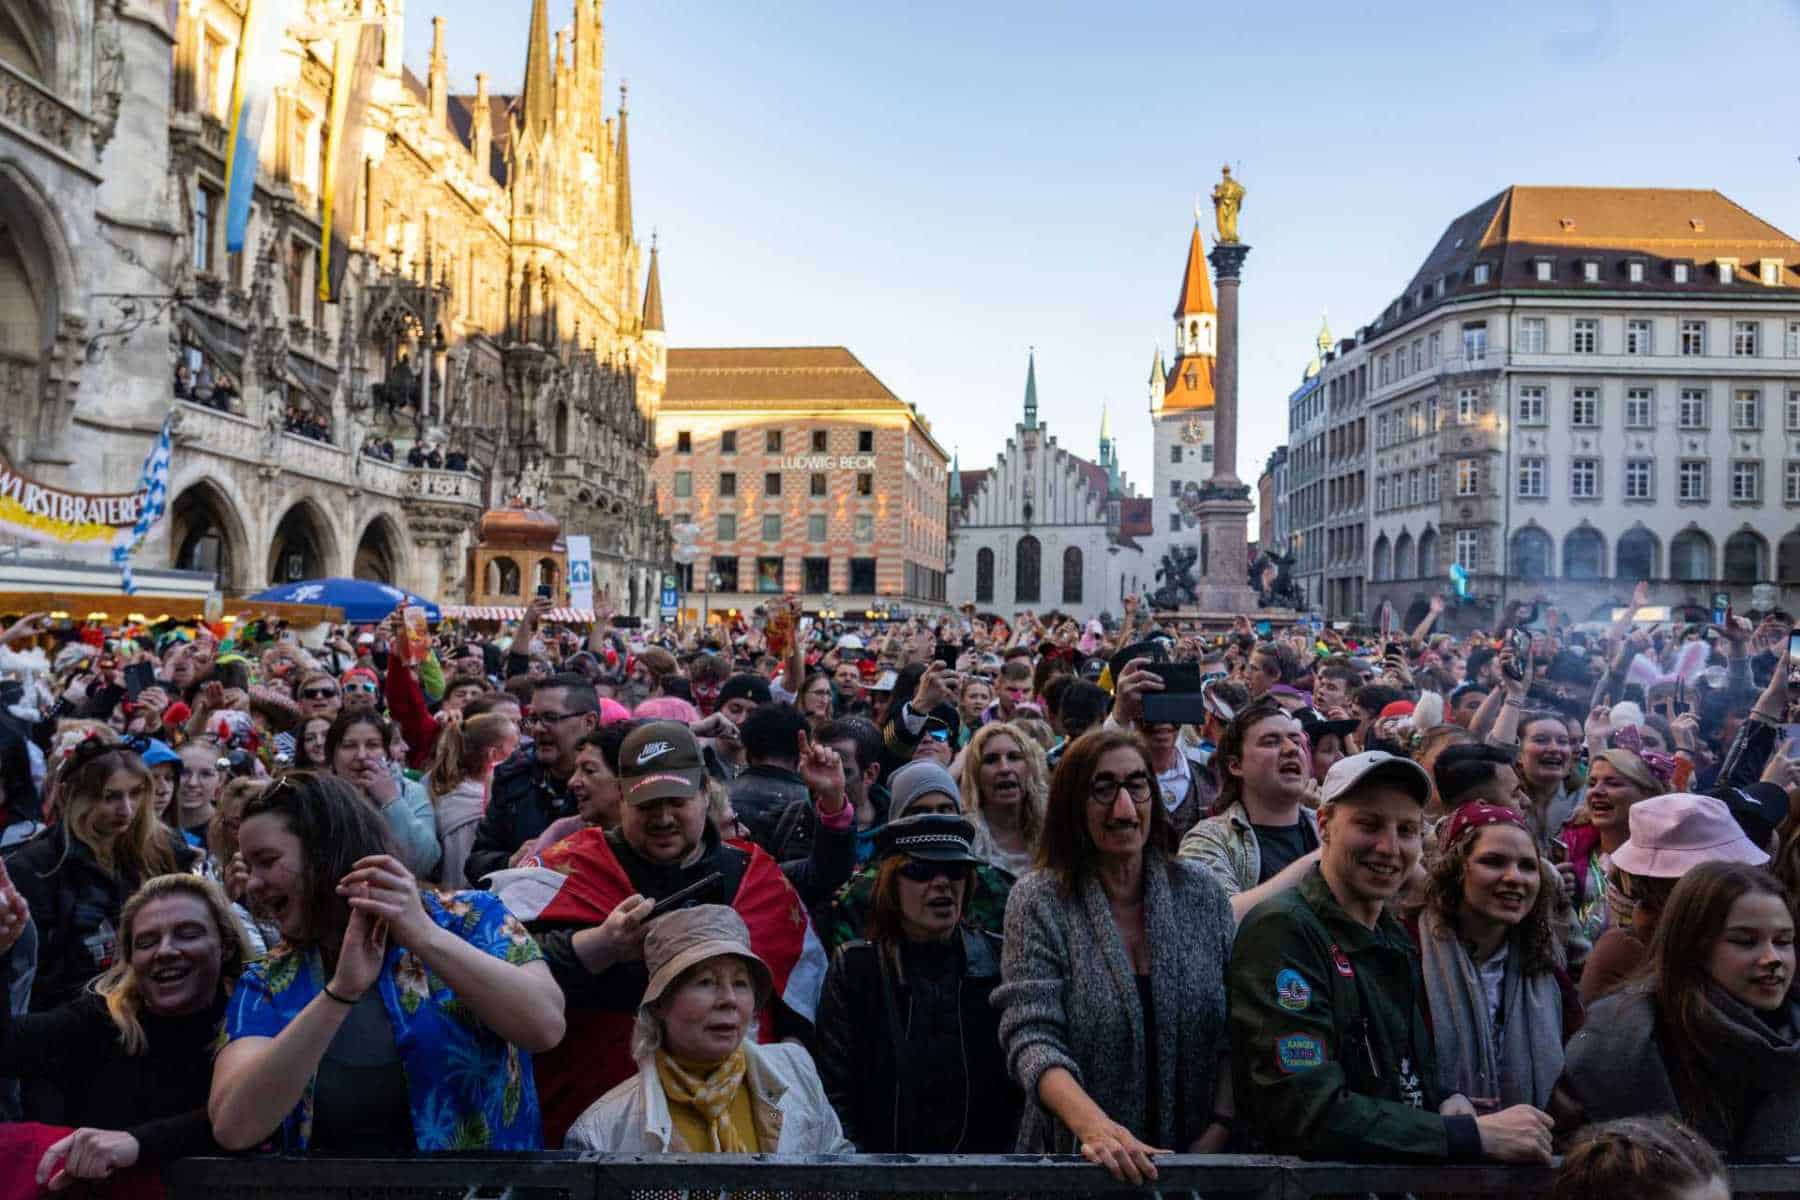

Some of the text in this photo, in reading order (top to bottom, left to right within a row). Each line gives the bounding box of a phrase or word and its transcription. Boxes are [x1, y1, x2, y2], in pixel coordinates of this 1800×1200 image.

[781, 455, 877, 470] LUDWIG BECK
[664, 575, 676, 589] S
[663, 591, 675, 605] U
[642, 742, 669, 754] NIKE
